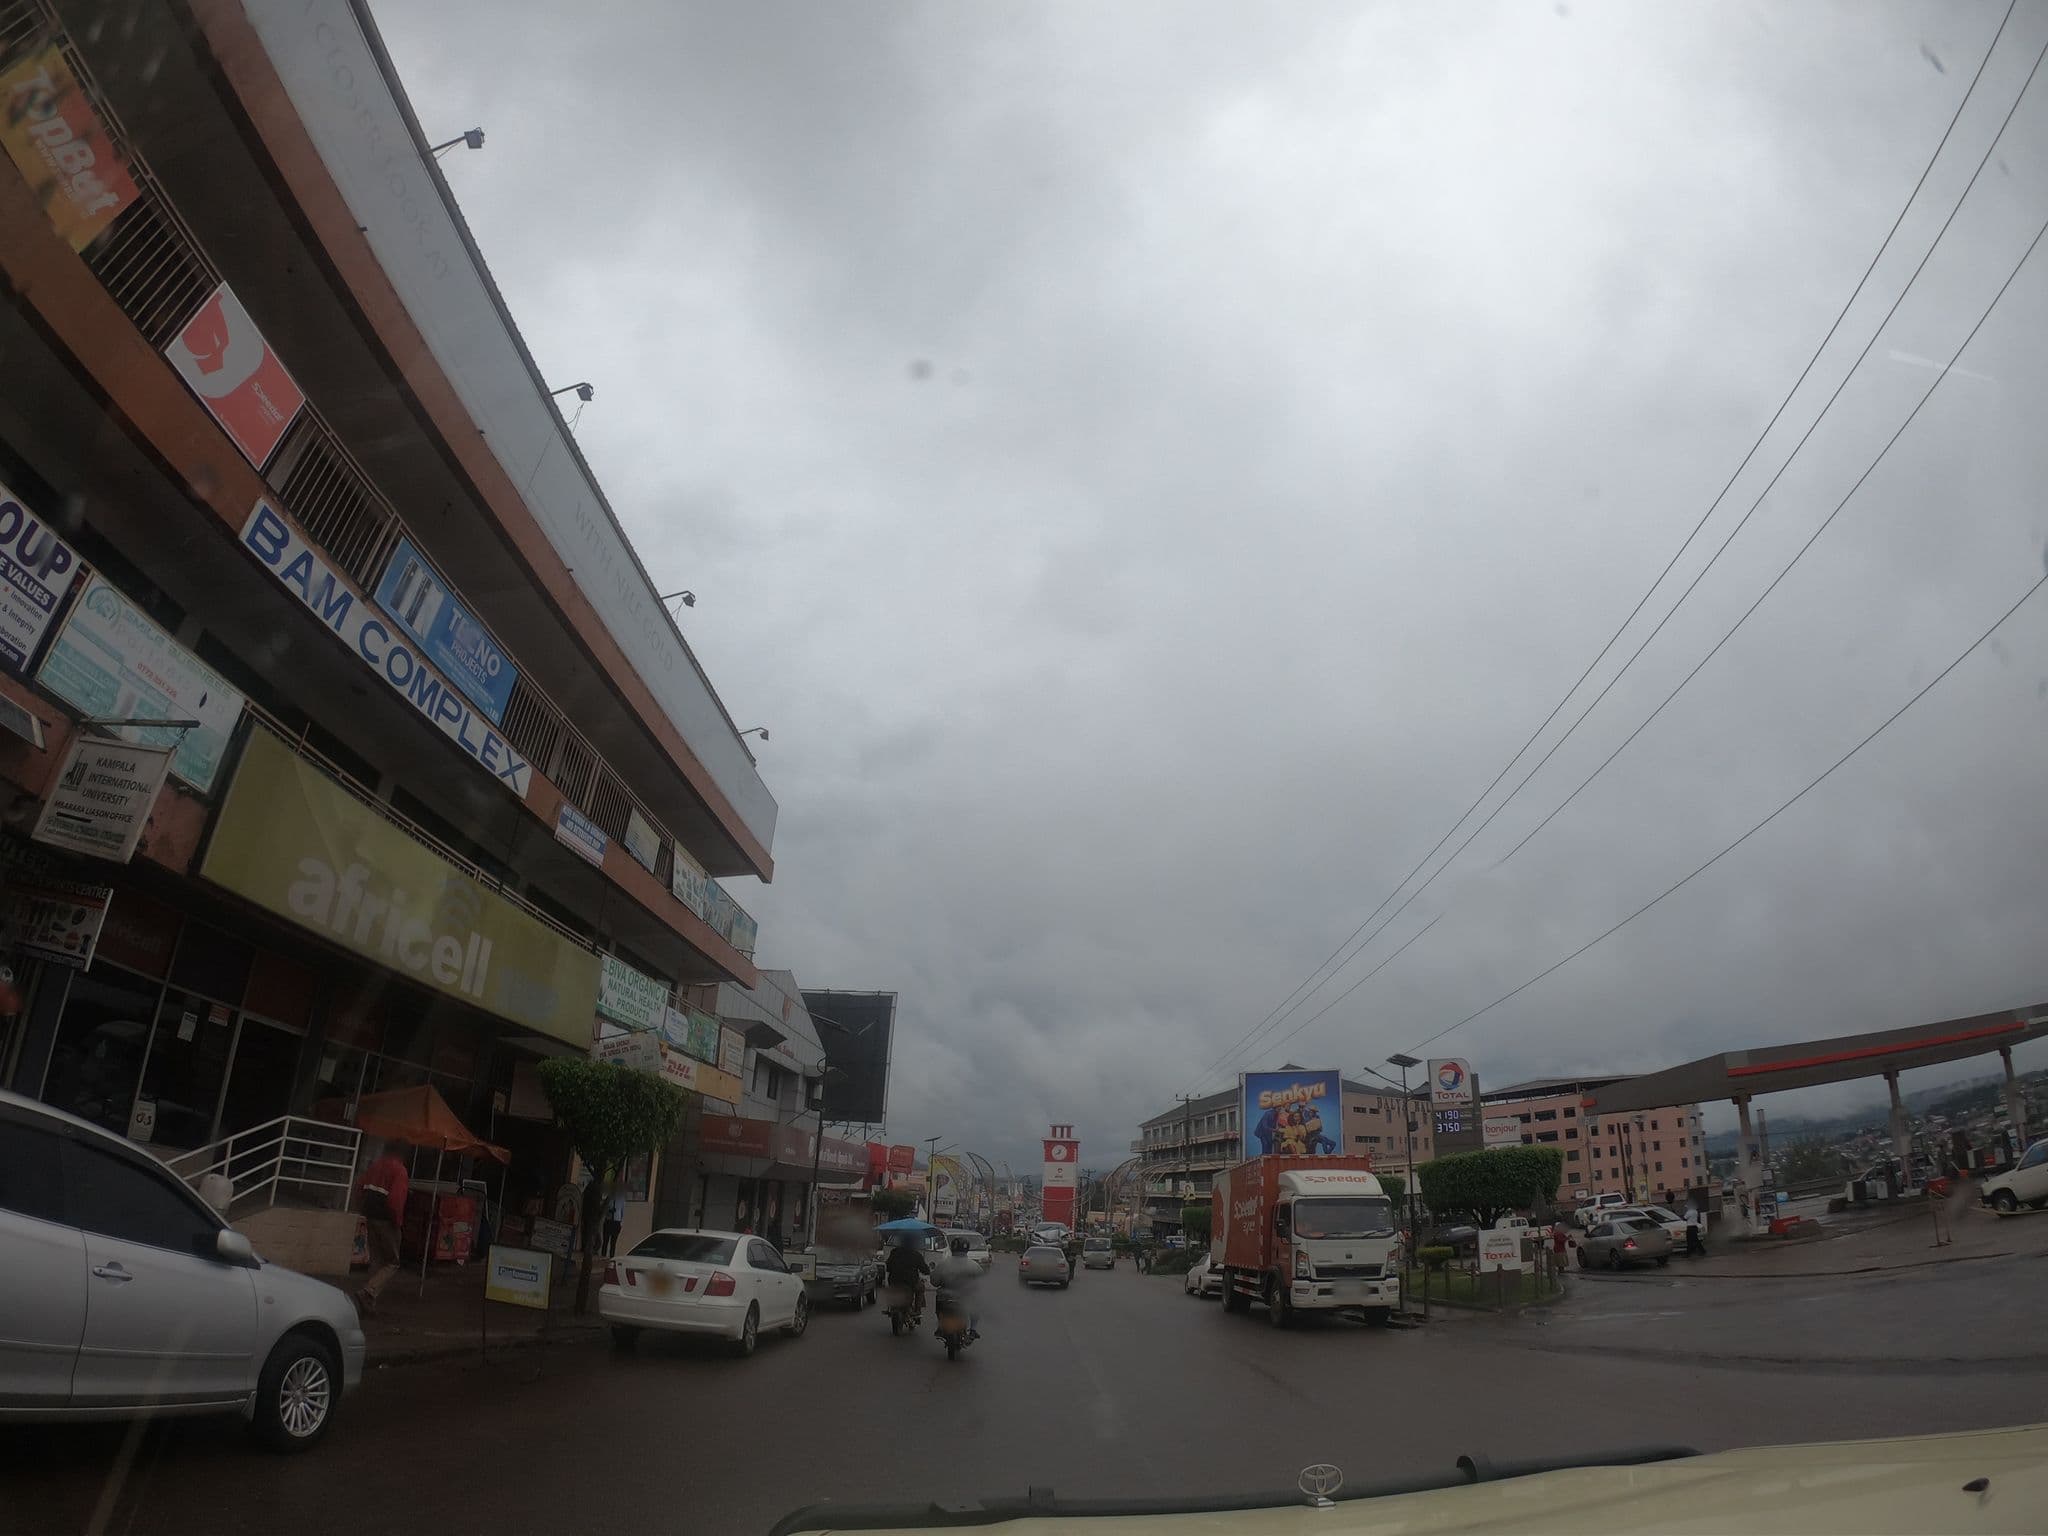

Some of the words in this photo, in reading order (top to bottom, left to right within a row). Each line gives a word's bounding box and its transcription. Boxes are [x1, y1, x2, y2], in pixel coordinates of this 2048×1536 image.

[10, 565, 52, 608] VALUES
[10, 590, 44, 621] Innovation
[8, 608, 37, 635] Integrity
[245, 504, 354, 632] BAM
[359, 620, 527, 792] COMPLEX
[450, 639, 489, 685] PROJECTS
[96, 758, 136, 773] KAMPALA
[87, 772, 152, 795] INTERNATIONAL
[81, 789, 131, 808] UNIVERSITY
[287, 856, 495, 998] africell
[608, 959, 627, 982] BIVA
[628, 969, 660, 1001] ORGANIC
[607, 978, 638, 1004] NATURAL
[638, 994, 662, 1013] HEALTH
[616, 998, 650, 1021] PRODUCTS
[1259, 1081, 1326, 1109] Senkyu
[1435, 1090, 1470, 1100] TOTAL
[1436, 1110, 1460, 1120] 4190
[1437, 1122, 1461, 1133] 3750
[1485, 1123, 1517, 1137] bonjour
[1304, 1175, 1369, 1185] Speedaf
[1483, 1251, 1518, 1261] TOTAL
